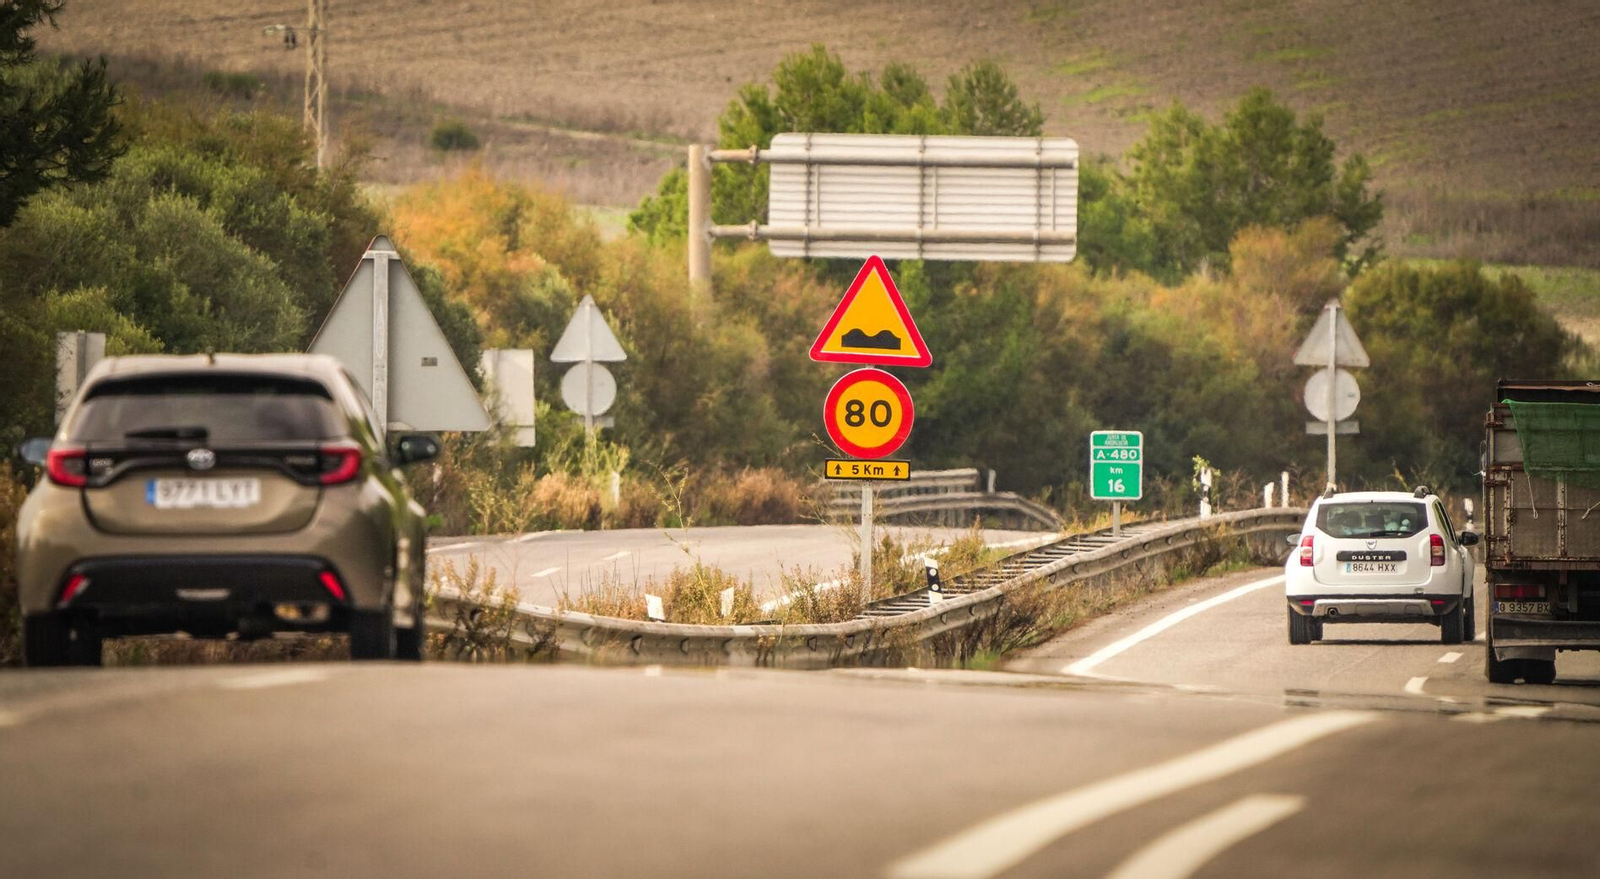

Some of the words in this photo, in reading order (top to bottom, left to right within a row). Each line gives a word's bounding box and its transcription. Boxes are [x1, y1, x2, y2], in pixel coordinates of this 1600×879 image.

[844, 399, 892, 428] 80
[1096, 449, 1138, 460] A-480
[851, 464, 860, 475] 5
[863, 464, 884, 475] Km
[1109, 466, 1124, 475] km
[1107, 478, 1126, 493] 16
[1352, 563, 1374, 572] 8644
[1377, 563, 1396, 572] HXX
[1508, 603, 1535, 613] 9357
[1537, 603, 1550, 613] BX
